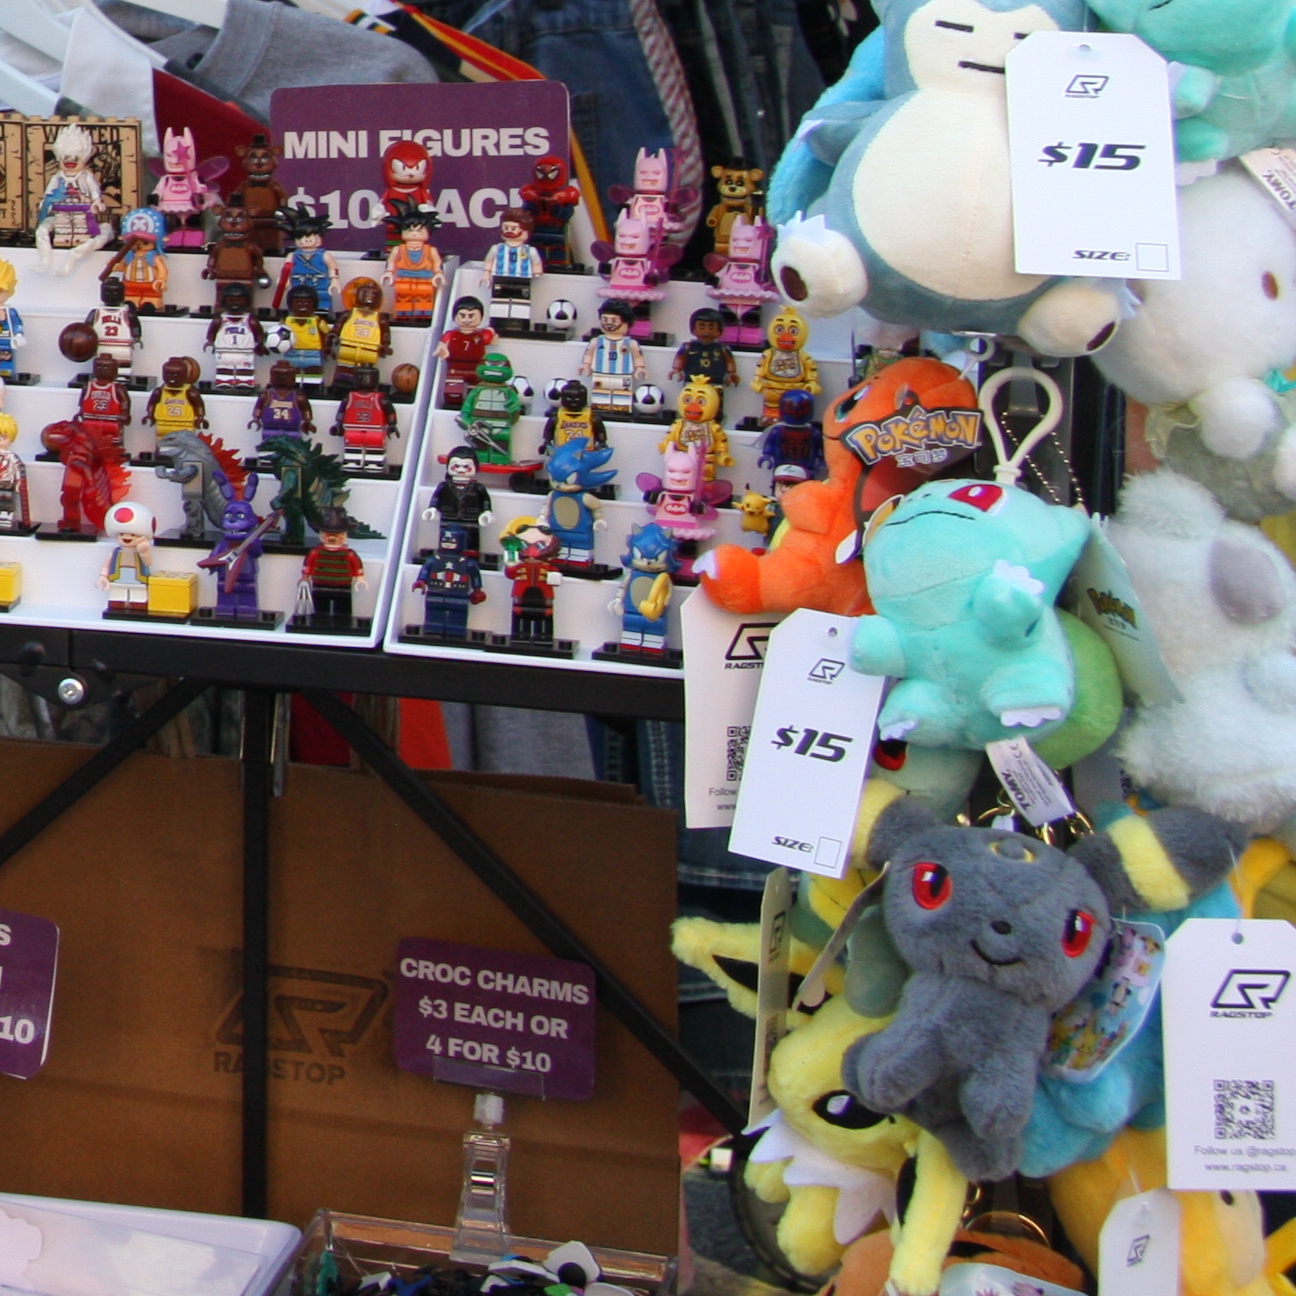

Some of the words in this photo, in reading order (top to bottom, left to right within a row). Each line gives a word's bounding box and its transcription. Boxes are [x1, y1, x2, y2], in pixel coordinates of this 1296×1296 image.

[283, 130, 368, 159] MINI
[1037, 141, 1147, 170] $15
[104, 326, 117, 336] 23
[273, 409, 289, 420] 34
[771, 725, 853, 762] $15
[1001, 769, 1030, 810] TOMY
[400, 958, 471, 986] CROC
[477, 969, 589, 1005] CHARMS
[418, 995, 448, 1019] $3
[454, 1002, 524, 1032] EACH
[530, 1015, 568, 1039] OR
[1210, 1010, 1273, 1019] RAGSTOP
[426, 1035, 442, 1055] 4
[448, 1038, 500, 1064] FOR
[506, 1047, 552, 1073] $10
[1194, 1145, 1228, 1155] Follow
[1231, 1147, 1243, 1155] us
[1204, 1163, 1287, 1173] www.ragstop.ca
